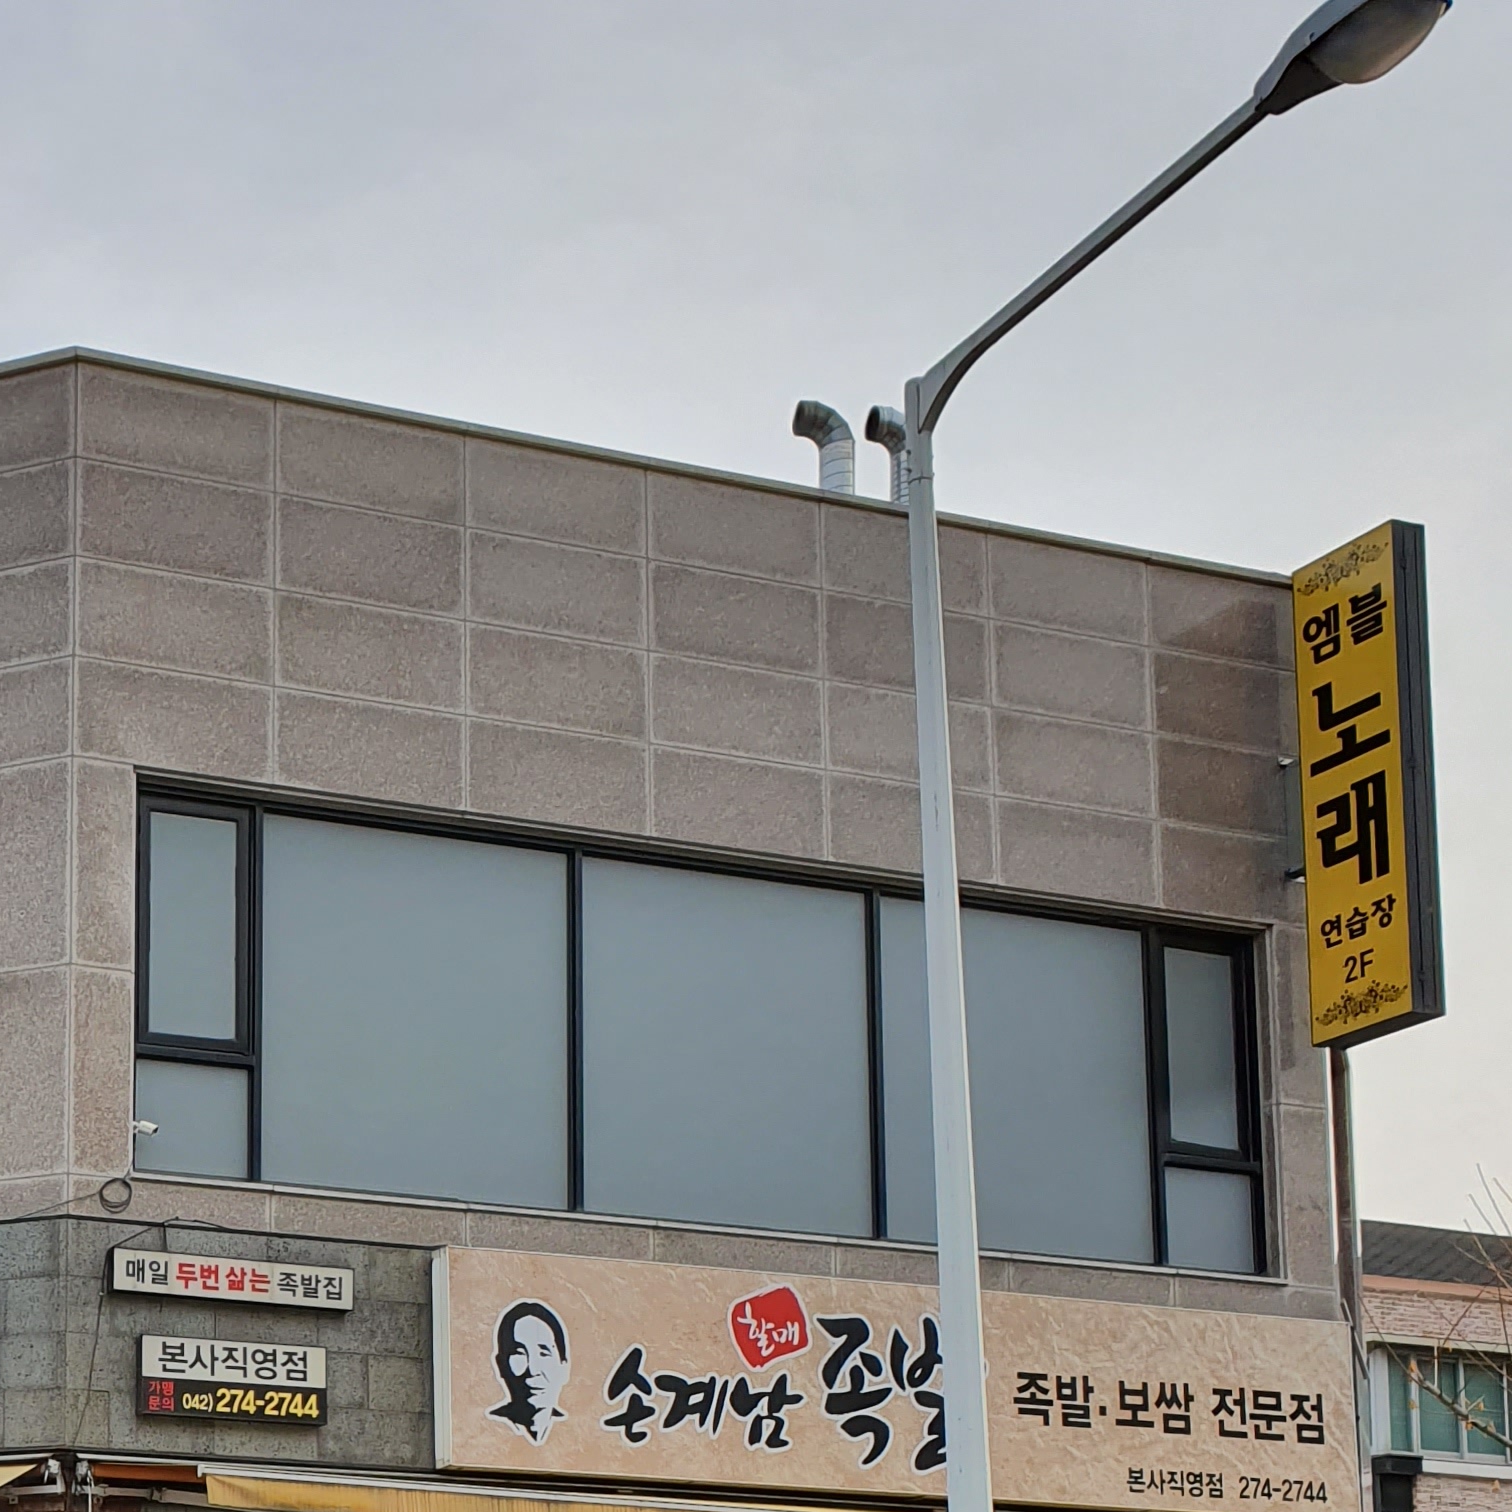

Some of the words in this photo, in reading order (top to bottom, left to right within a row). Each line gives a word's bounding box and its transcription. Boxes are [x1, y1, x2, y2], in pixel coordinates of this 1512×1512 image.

[1302, 583, 1387, 665] 엠블
[1309, 681, 1391, 885] 노래
[1320, 895, 1396, 949] 연습장
[1342, 950, 1374, 983] 2F
[126, 1259, 169, 1285] 매일
[176, 1262, 220, 1290] 두번
[225, 1266, 271, 1293] 삶는
[276, 1271, 343, 1300] 족발집
[158, 1341, 308, 1381] 본사직영점
[148, 1381, 175, 1396] 가맹
[148, 1397, 175, 1412] 문의
[604, 1346, 803, 1450] 손계남
[1211, 1387, 1326, 1444] 전문점
[1127, 1467, 1224, 1499] 본사직영점
[1238, 1476, 1328, 1503] 274-2744
